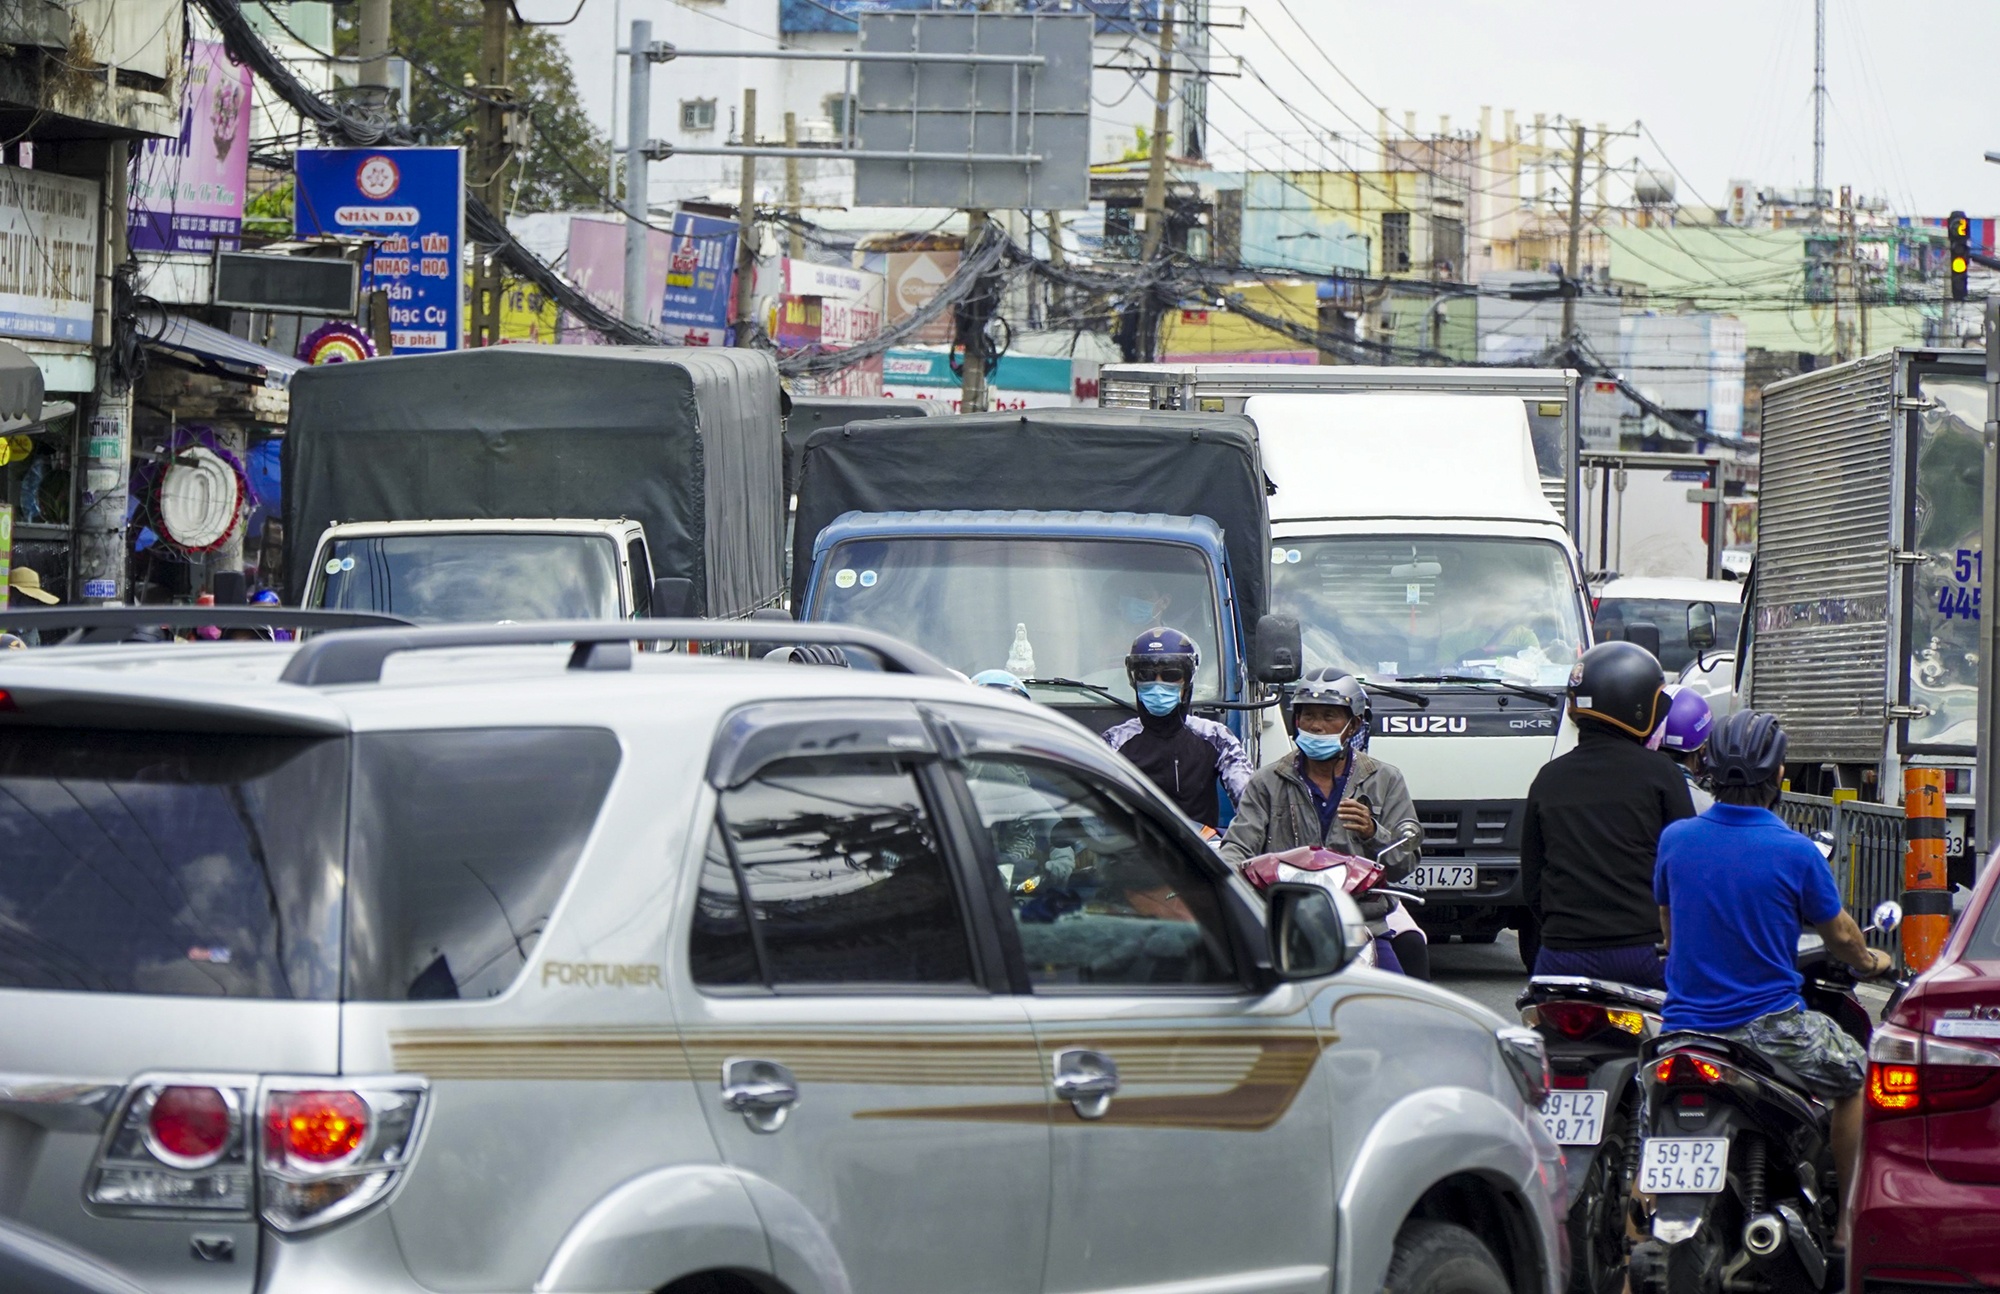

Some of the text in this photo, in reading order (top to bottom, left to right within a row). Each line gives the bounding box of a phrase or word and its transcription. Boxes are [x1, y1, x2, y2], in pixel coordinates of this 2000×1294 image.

[373, 258, 410, 279] NHẠC
[389, 306, 447, 327] hạc Cụ
[1382, 716, 1467, 733] ISUZU
[1509, 719, 1552, 729] QKR
[542, 961, 664, 989] FORTUNER
[1657, 1142, 1716, 1164] 59-P2
[1646, 1166, 1720, 1189] 554.67
